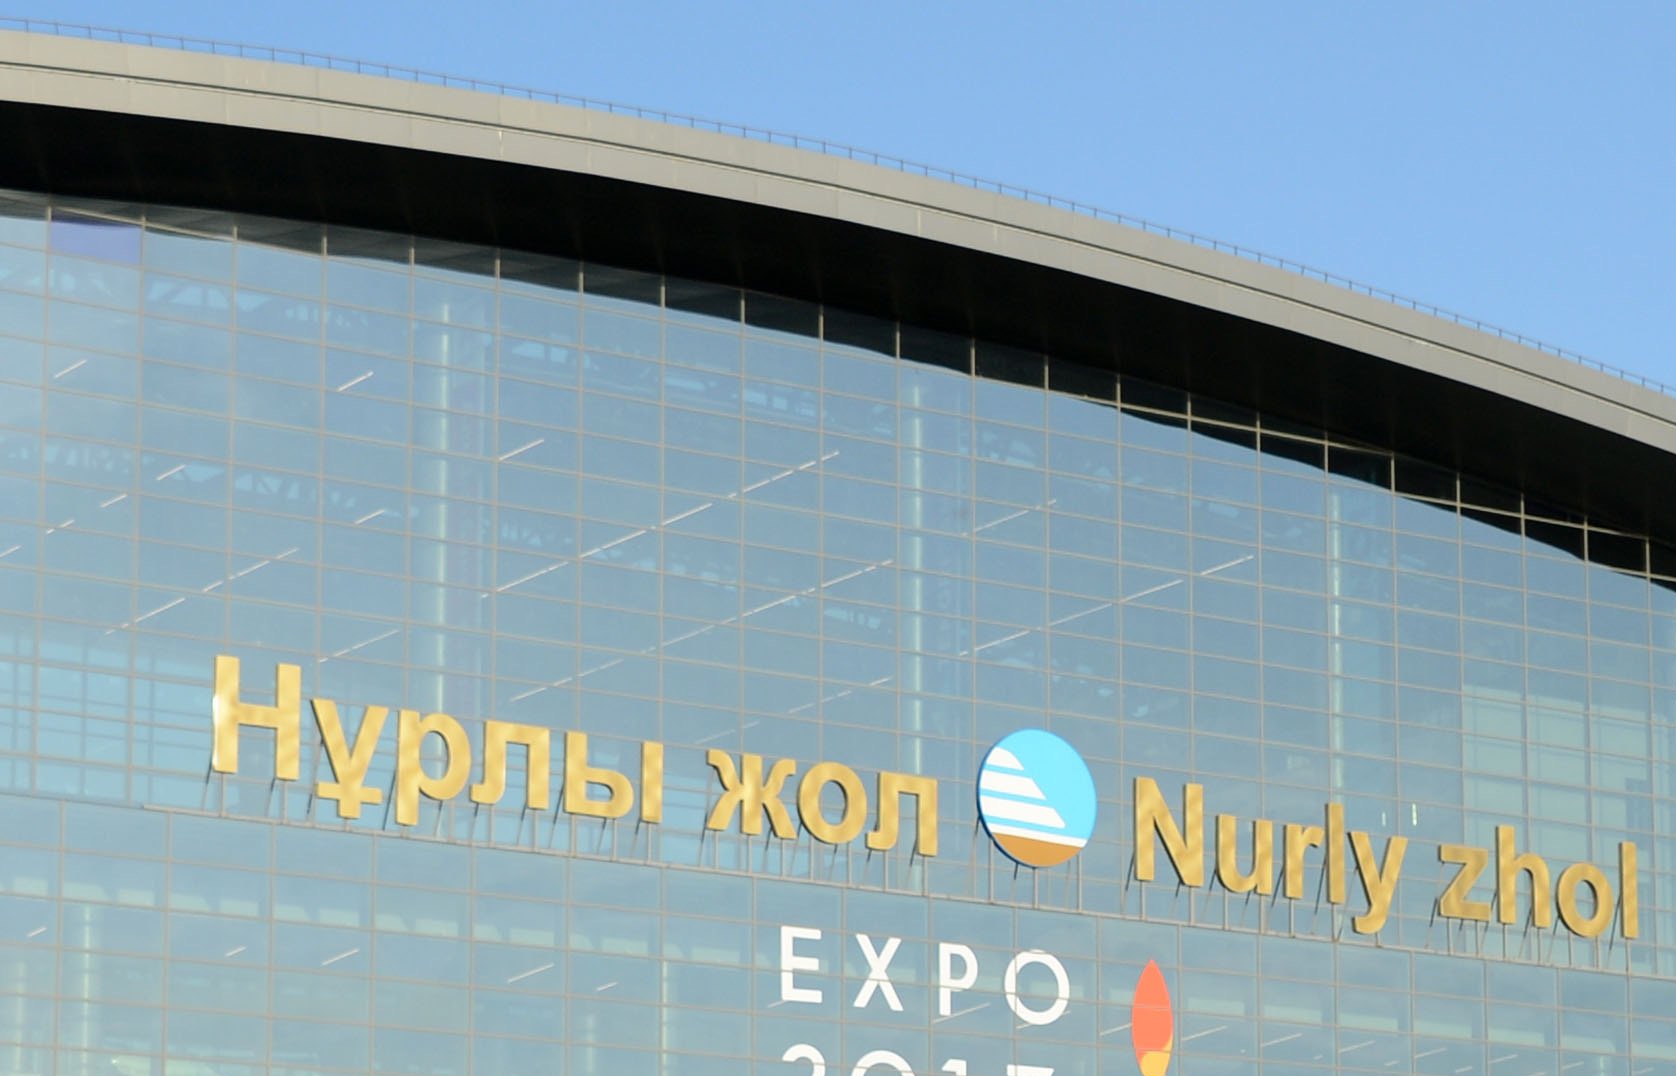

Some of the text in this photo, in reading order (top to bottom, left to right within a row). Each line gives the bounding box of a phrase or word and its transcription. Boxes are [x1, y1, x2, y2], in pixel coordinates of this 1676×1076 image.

[211, 655, 939, 857] Нұрлы жол
[1134, 776, 1640, 939] Nurly zhol
[780, 925, 1070, 1026] EXPO
